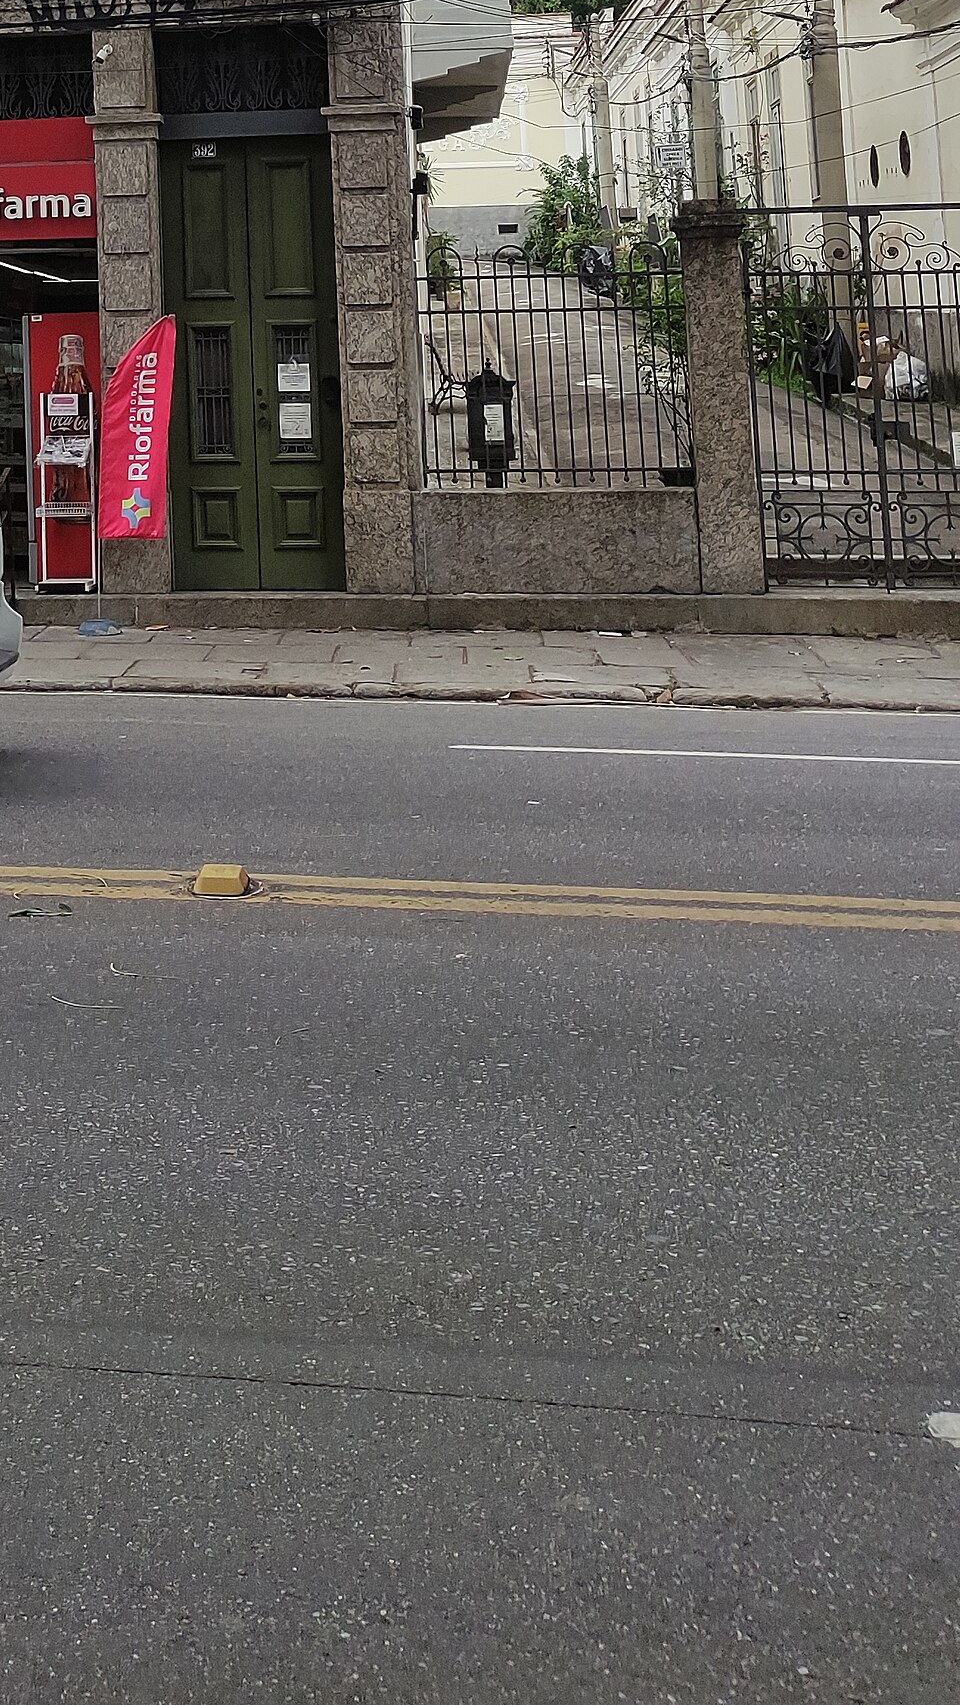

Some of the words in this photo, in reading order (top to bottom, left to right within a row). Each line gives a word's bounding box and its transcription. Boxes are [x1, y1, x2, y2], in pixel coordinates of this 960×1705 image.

[194, 143, 214, 156] 392
[128, 352, 158, 481] Riofarma
[129, 354, 143, 422] DROGARIAS
